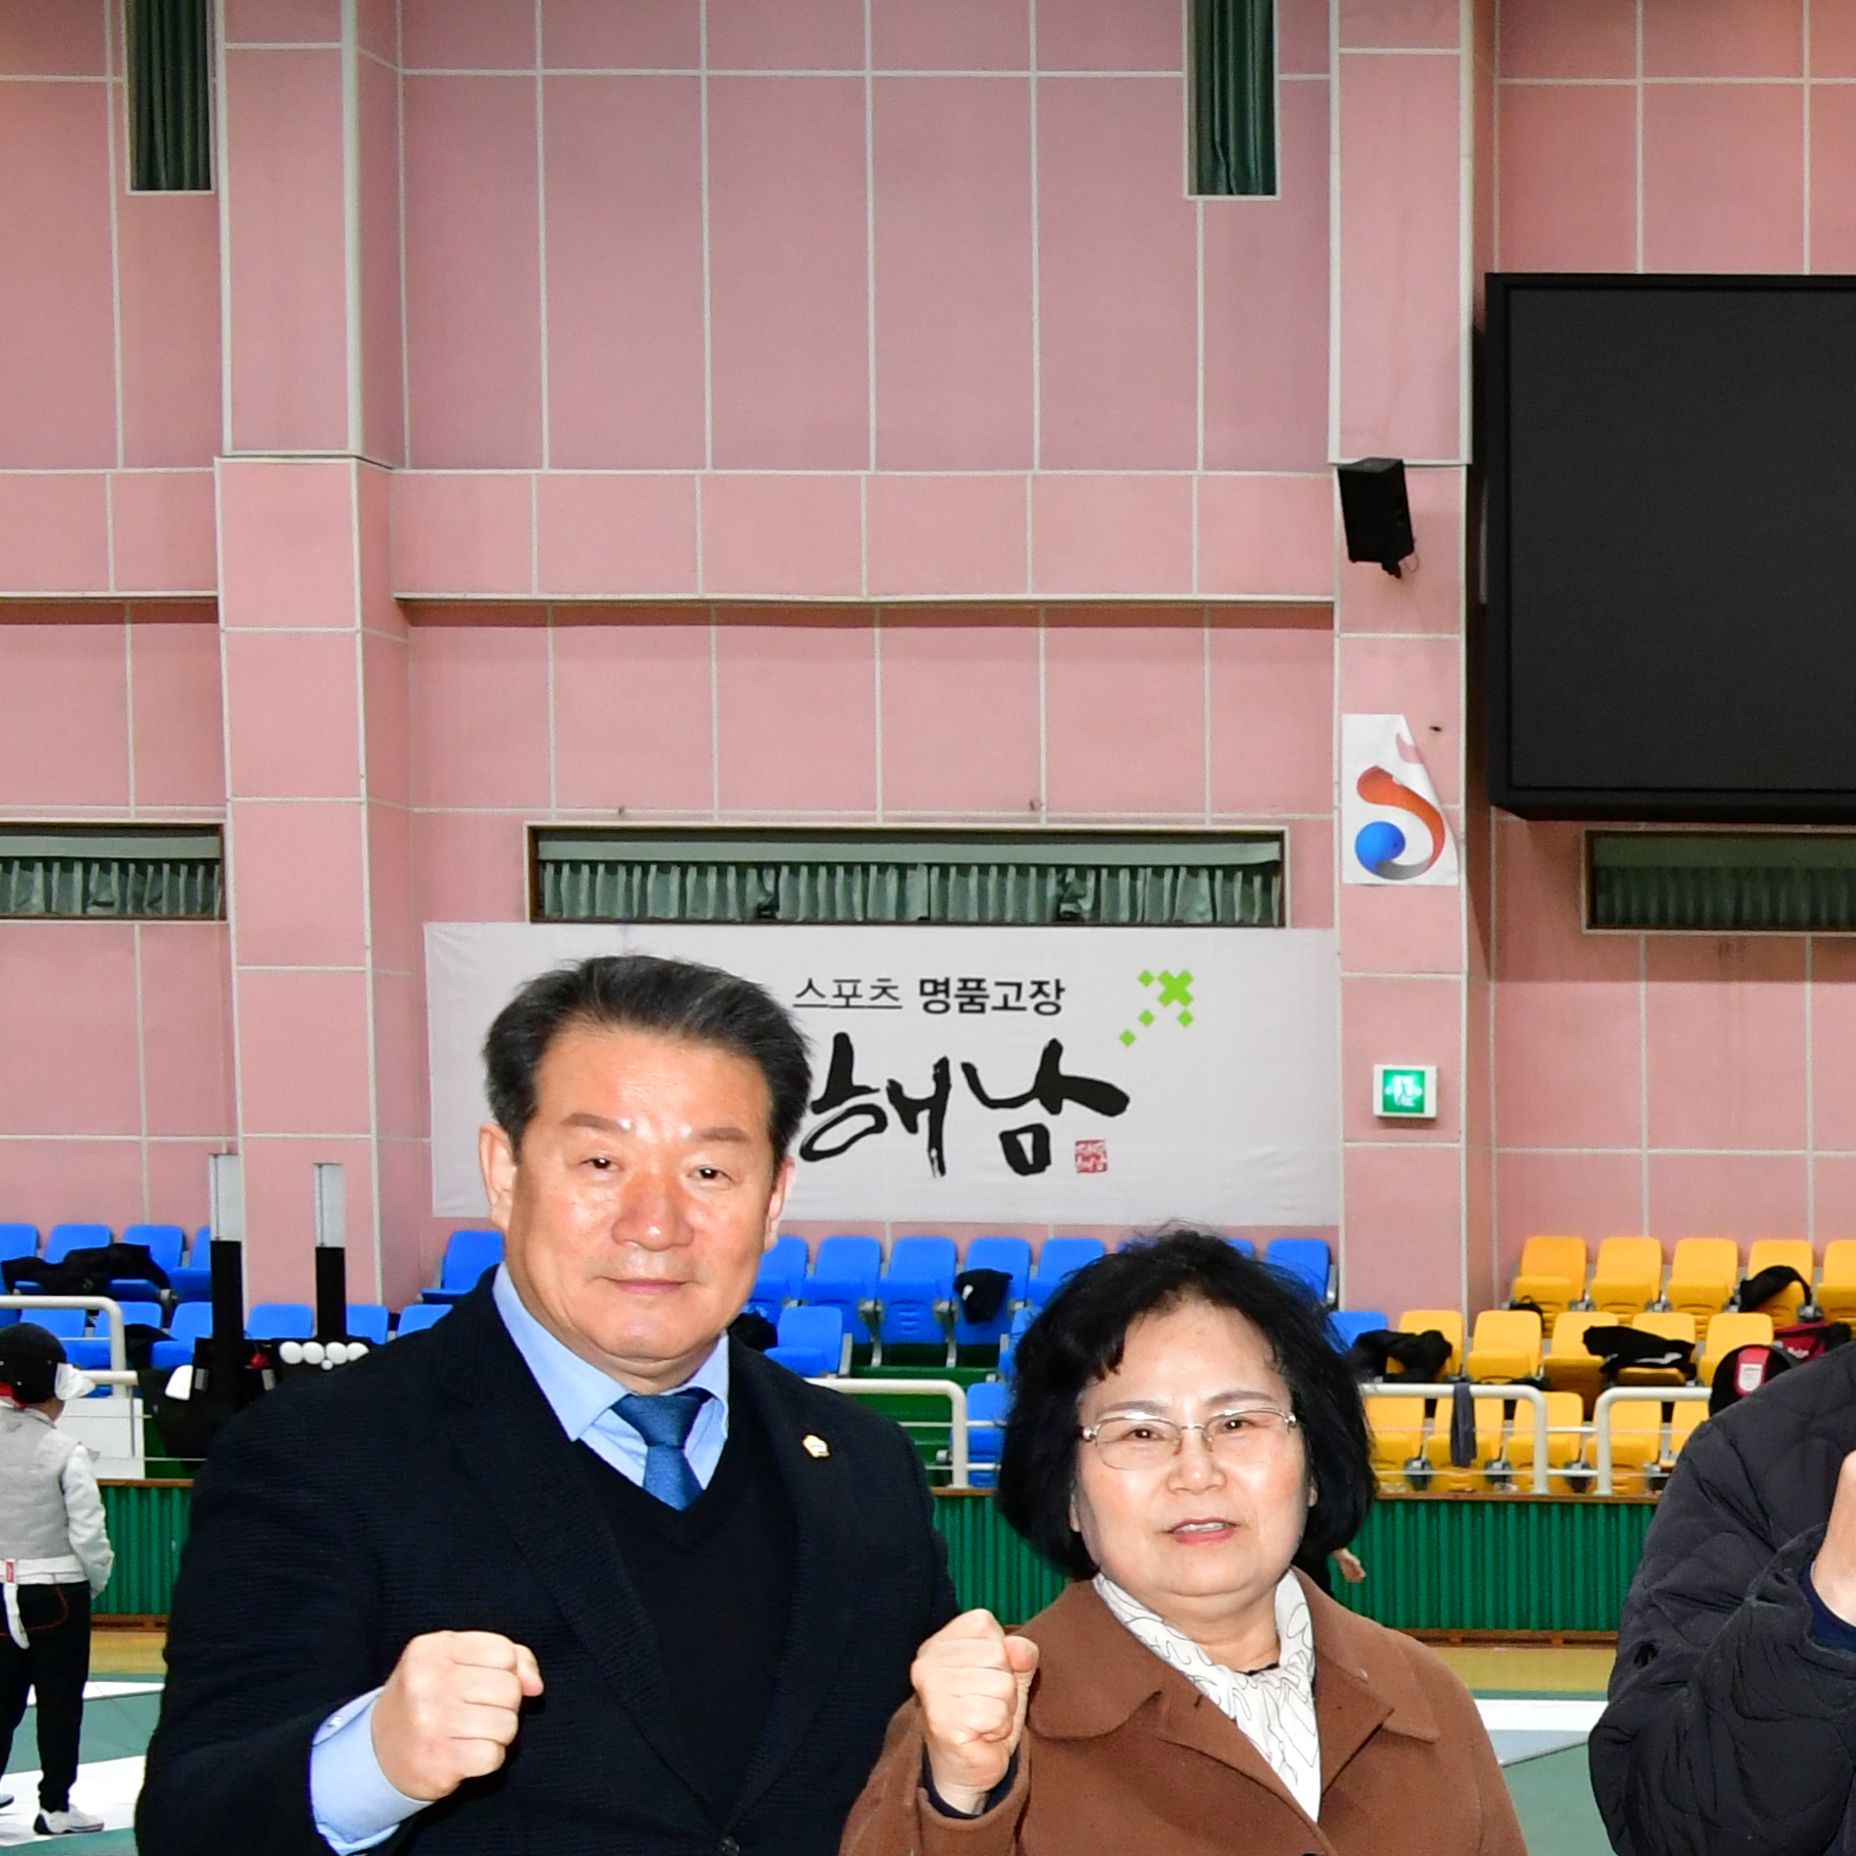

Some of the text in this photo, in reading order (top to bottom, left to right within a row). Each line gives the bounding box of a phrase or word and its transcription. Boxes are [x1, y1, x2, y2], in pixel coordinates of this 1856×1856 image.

[792, 976, 1066, 1017] 스포츠 명품고장
[800, 1031, 1131, 1178] 해남
